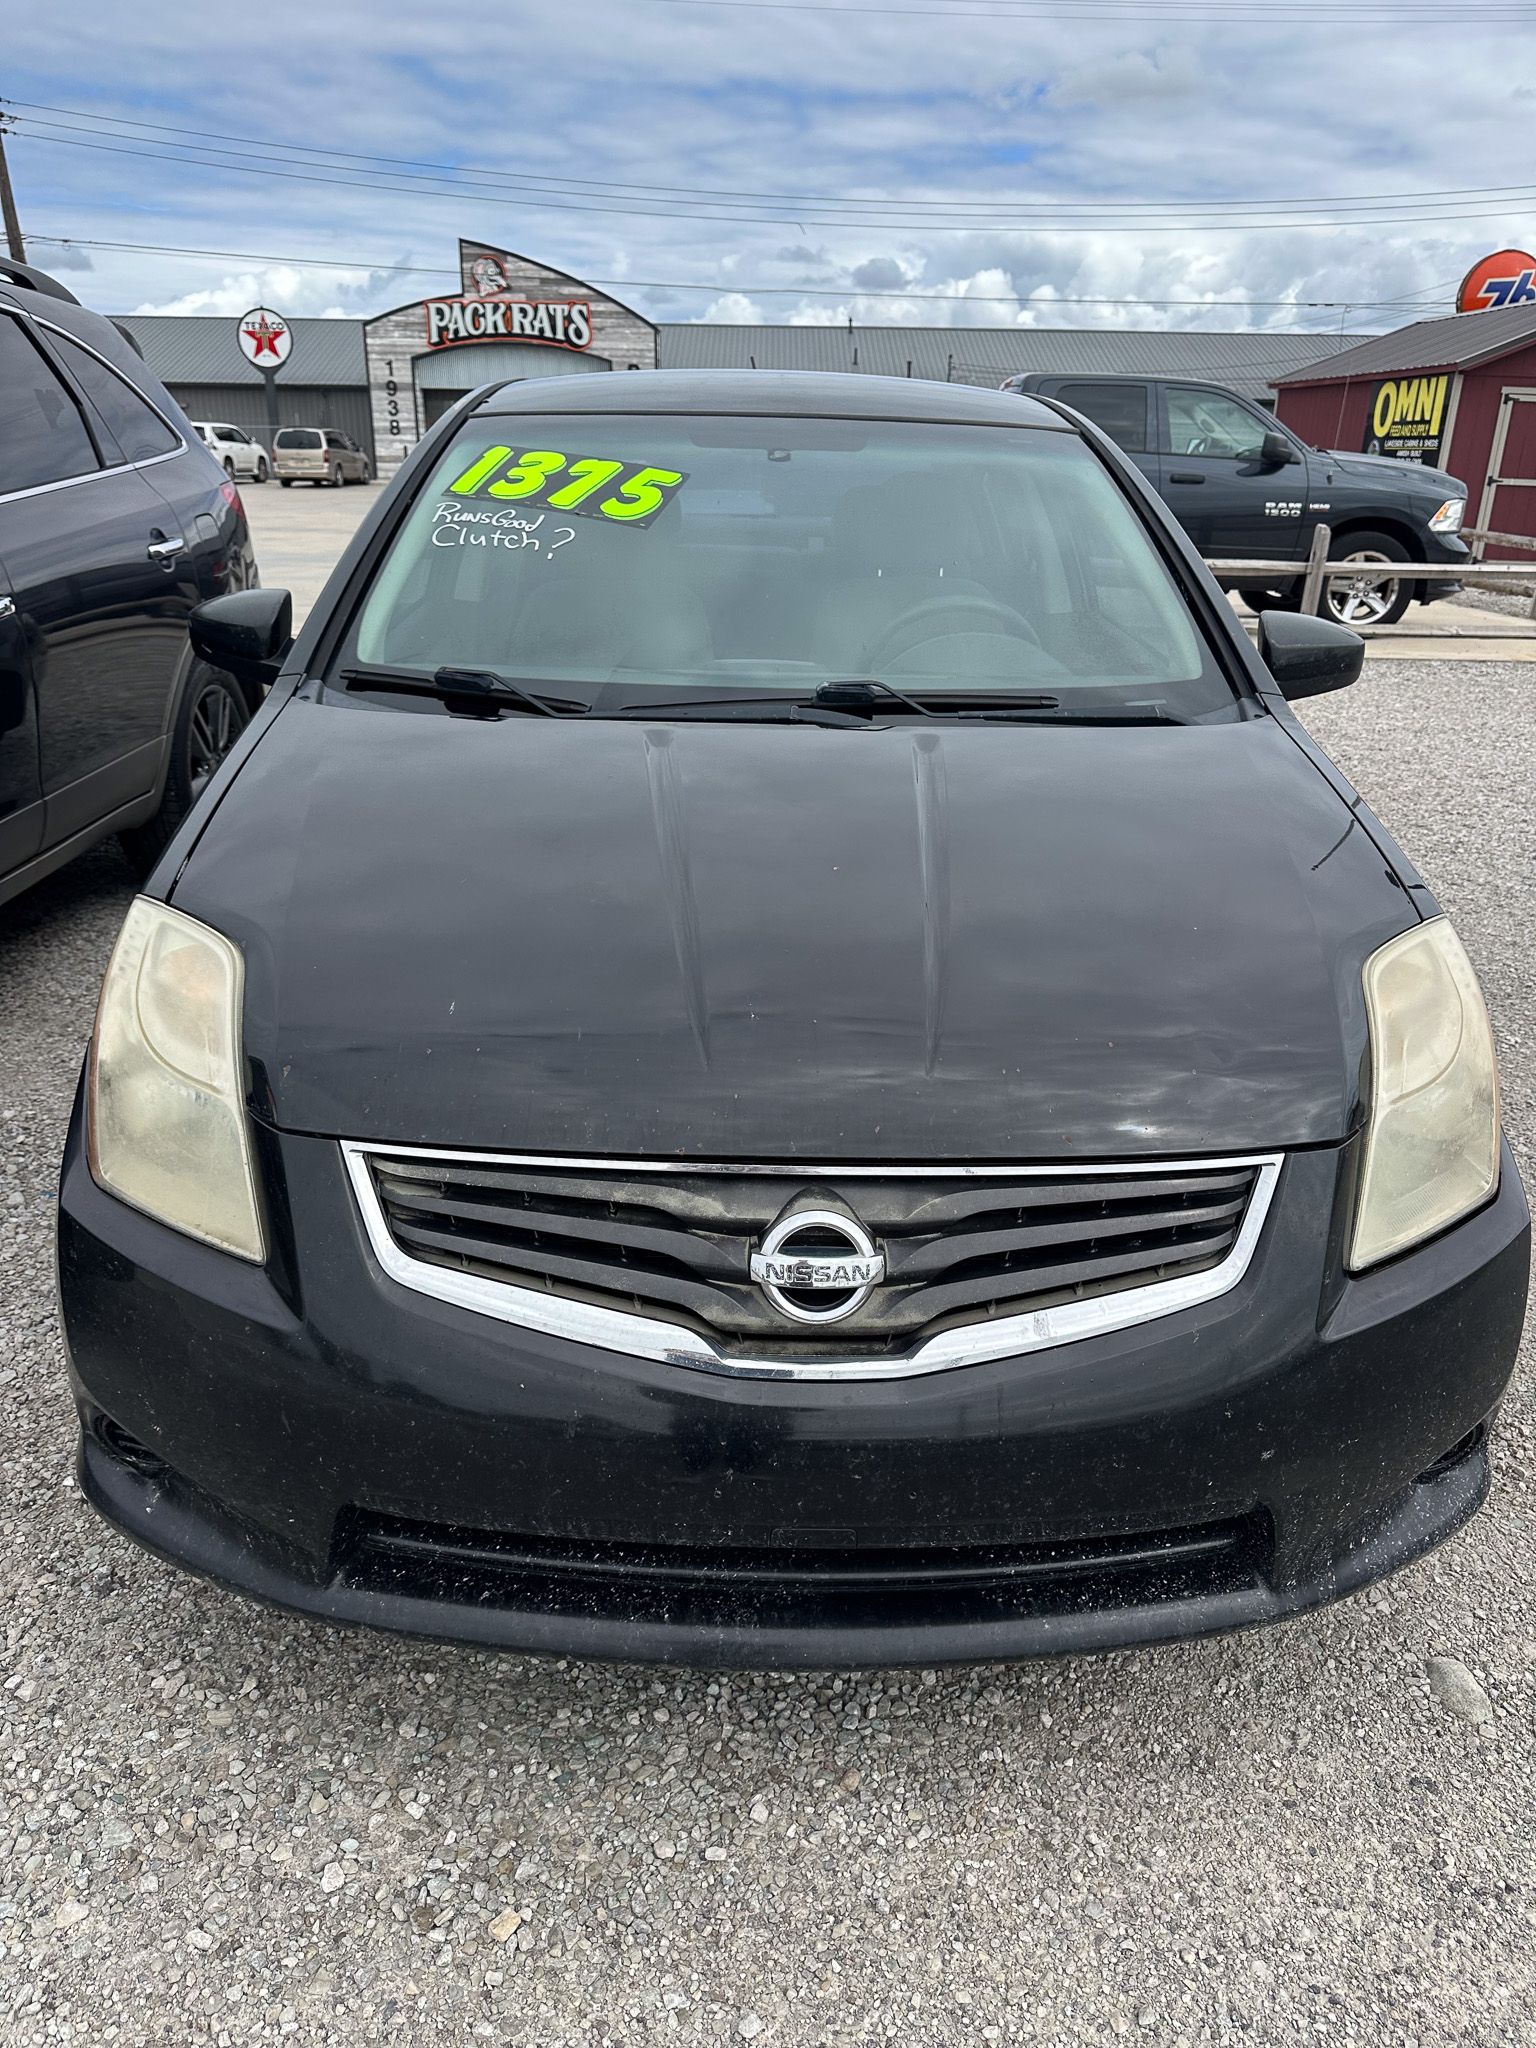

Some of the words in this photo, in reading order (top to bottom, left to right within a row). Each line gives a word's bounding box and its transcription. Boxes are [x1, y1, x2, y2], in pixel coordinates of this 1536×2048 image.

[244, 321, 284, 331] TEXACO
[427, 302, 507, 344] PACK
[509, 303, 591, 346] RATS
[385, 360, 400, 435] 1938
[1373, 375, 1448, 438] OMNI
[1389, 424, 1401, 437] FEED
[1401, 424, 1412, 436] AND
[1411, 424, 1430, 436] SUPPLY
[450, 446, 683, 521] 1375
[1264, 508, 1301, 517] 1500
[1265, 501, 1303, 509] RAM
[765, 1261, 871, 1282] NISSAN
